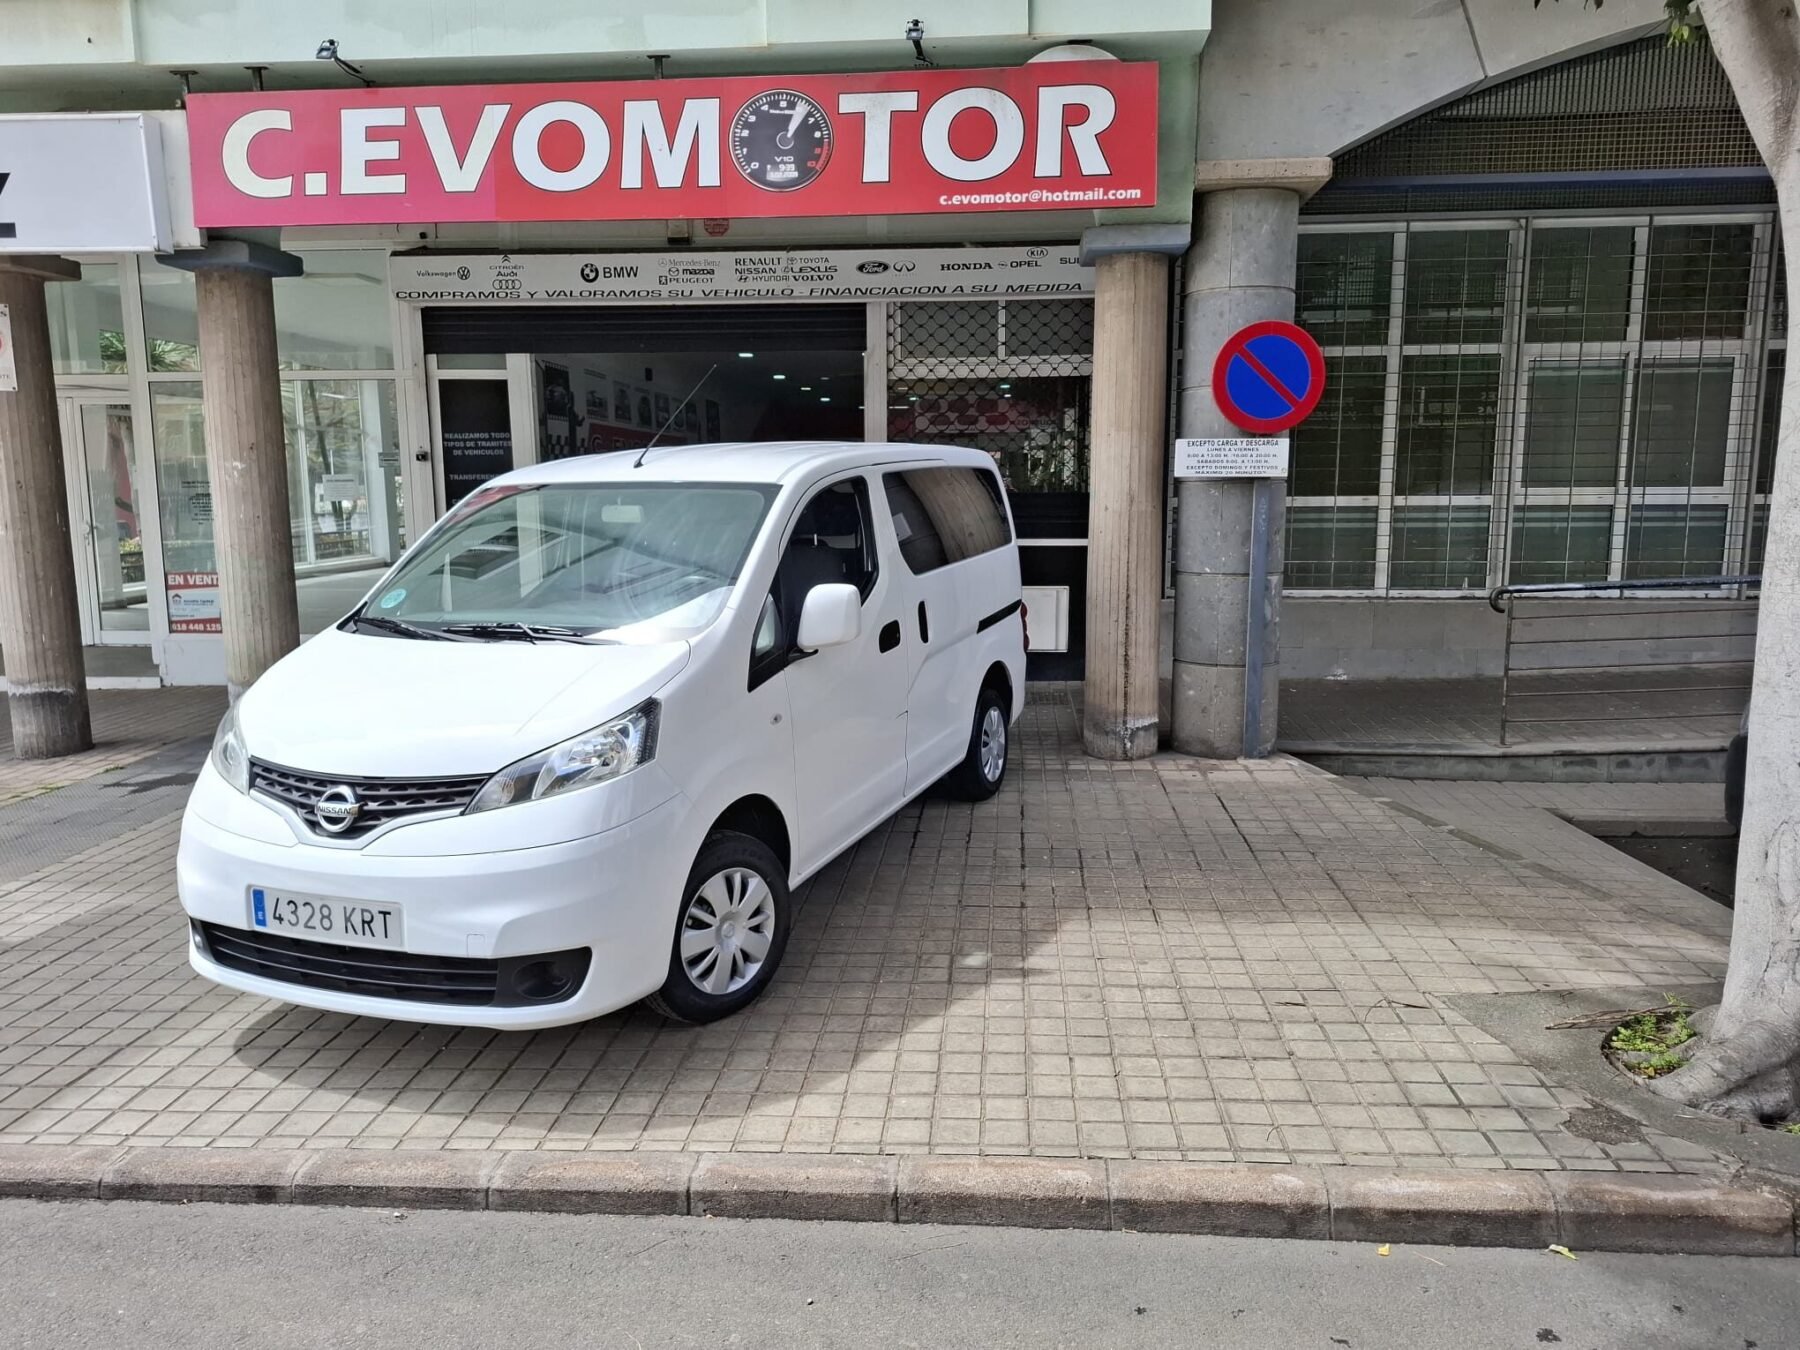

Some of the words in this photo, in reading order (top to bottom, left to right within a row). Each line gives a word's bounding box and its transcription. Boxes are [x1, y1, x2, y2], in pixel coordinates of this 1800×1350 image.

[939, 188, 1141, 205] c.evomotor@hotmail.com
[735, 257, 782, 266] RENAULT
[1010, 260, 1042, 268] OPEL
[735, 267, 776, 275] NISSAN
[940, 262, 993, 271] HONDA
[416, 270, 456, 278] Volkswagen
[603, 266, 638, 278] BMW
[669, 276, 714, 284] PEUGEOT
[793, 274, 834, 282] VOLVO
[395, 290, 521, 299] COMPRAMOS
[527, 290, 538, 299] Y
[545, 289, 662, 298] VALORAMOS
[668, 289, 693, 297] SU
[701, 288, 794, 297] VEHICULO
[809, 286, 947, 297] FINANCIACION
[952, 285, 964, 293] A
[970, 284, 998, 293] SU
[1005, 283, 1082, 293] MEDIDA
[167, 574, 184, 585] EN
[187, 574, 219, 585] VENT
[318, 804, 351, 816] NISSAN
[272, 897, 333, 931] 4328
[343, 905, 392, 939] KRT
